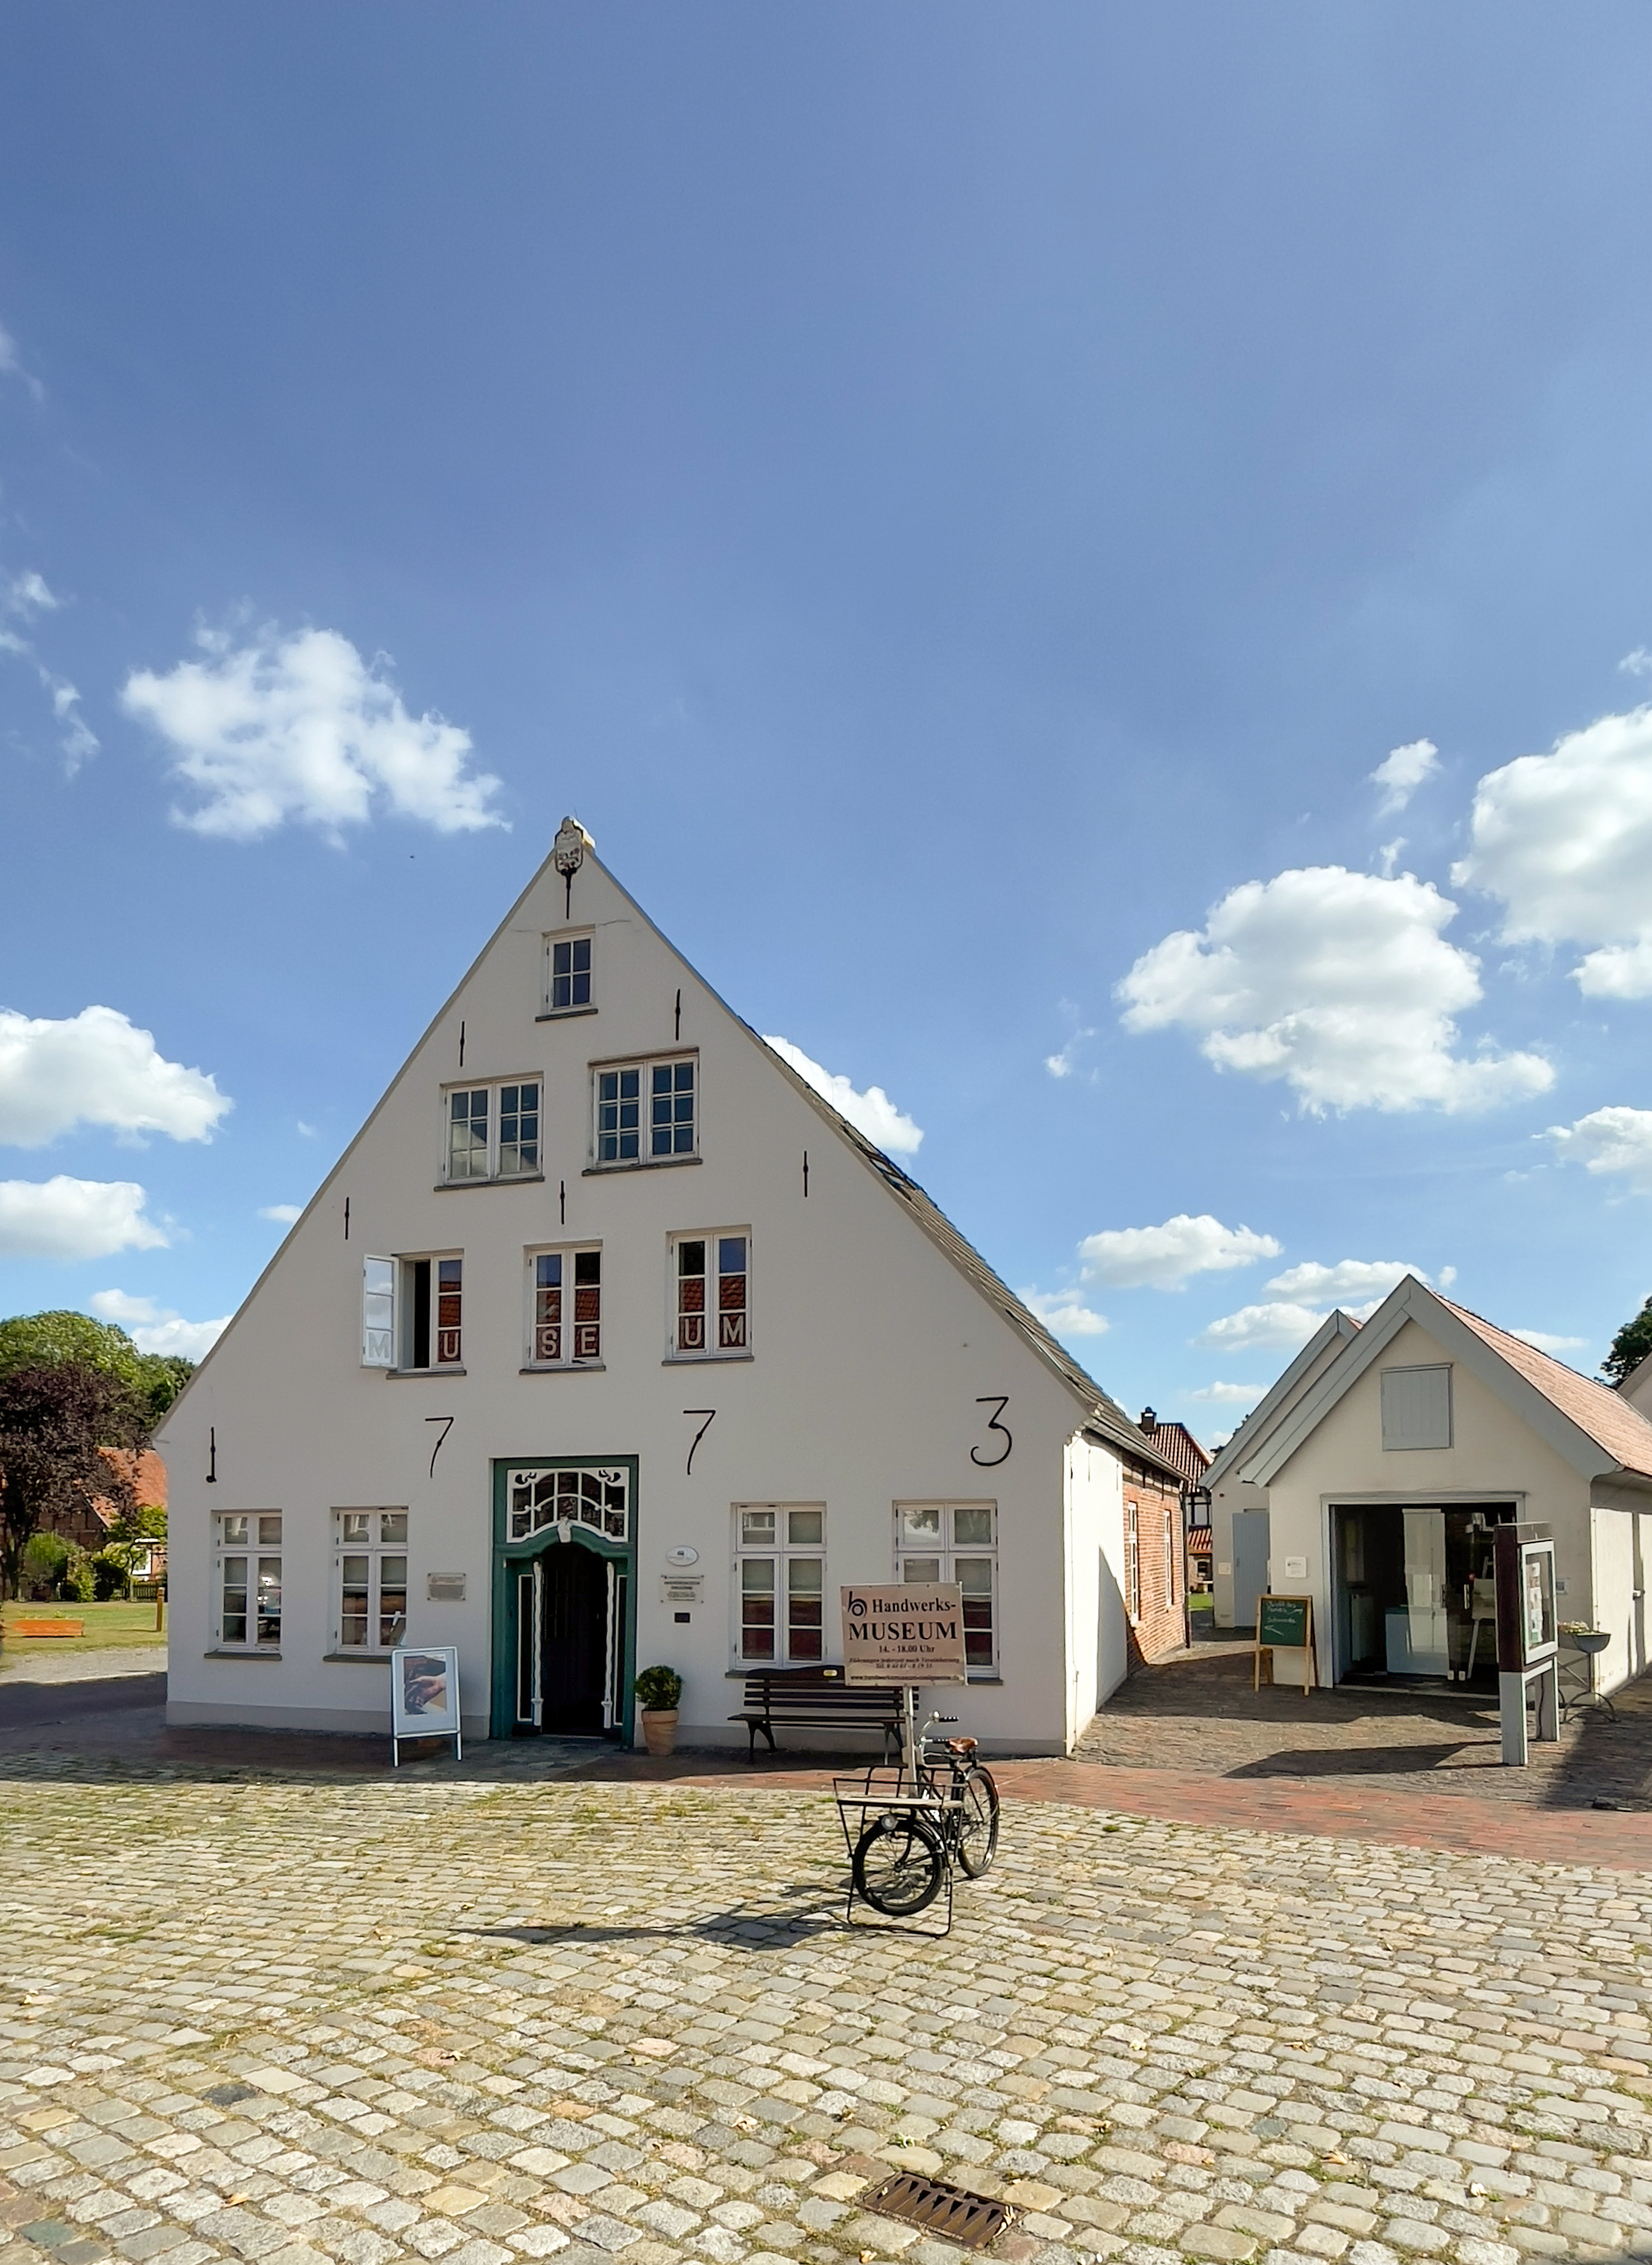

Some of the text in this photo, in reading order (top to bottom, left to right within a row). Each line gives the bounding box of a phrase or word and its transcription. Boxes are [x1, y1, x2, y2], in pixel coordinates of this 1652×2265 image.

[872, 1597, 957, 1613] Handwerks-
[848, 1621, 958, 1641] MUSEUM
[920, 1645, 936, 1653] Uhr
